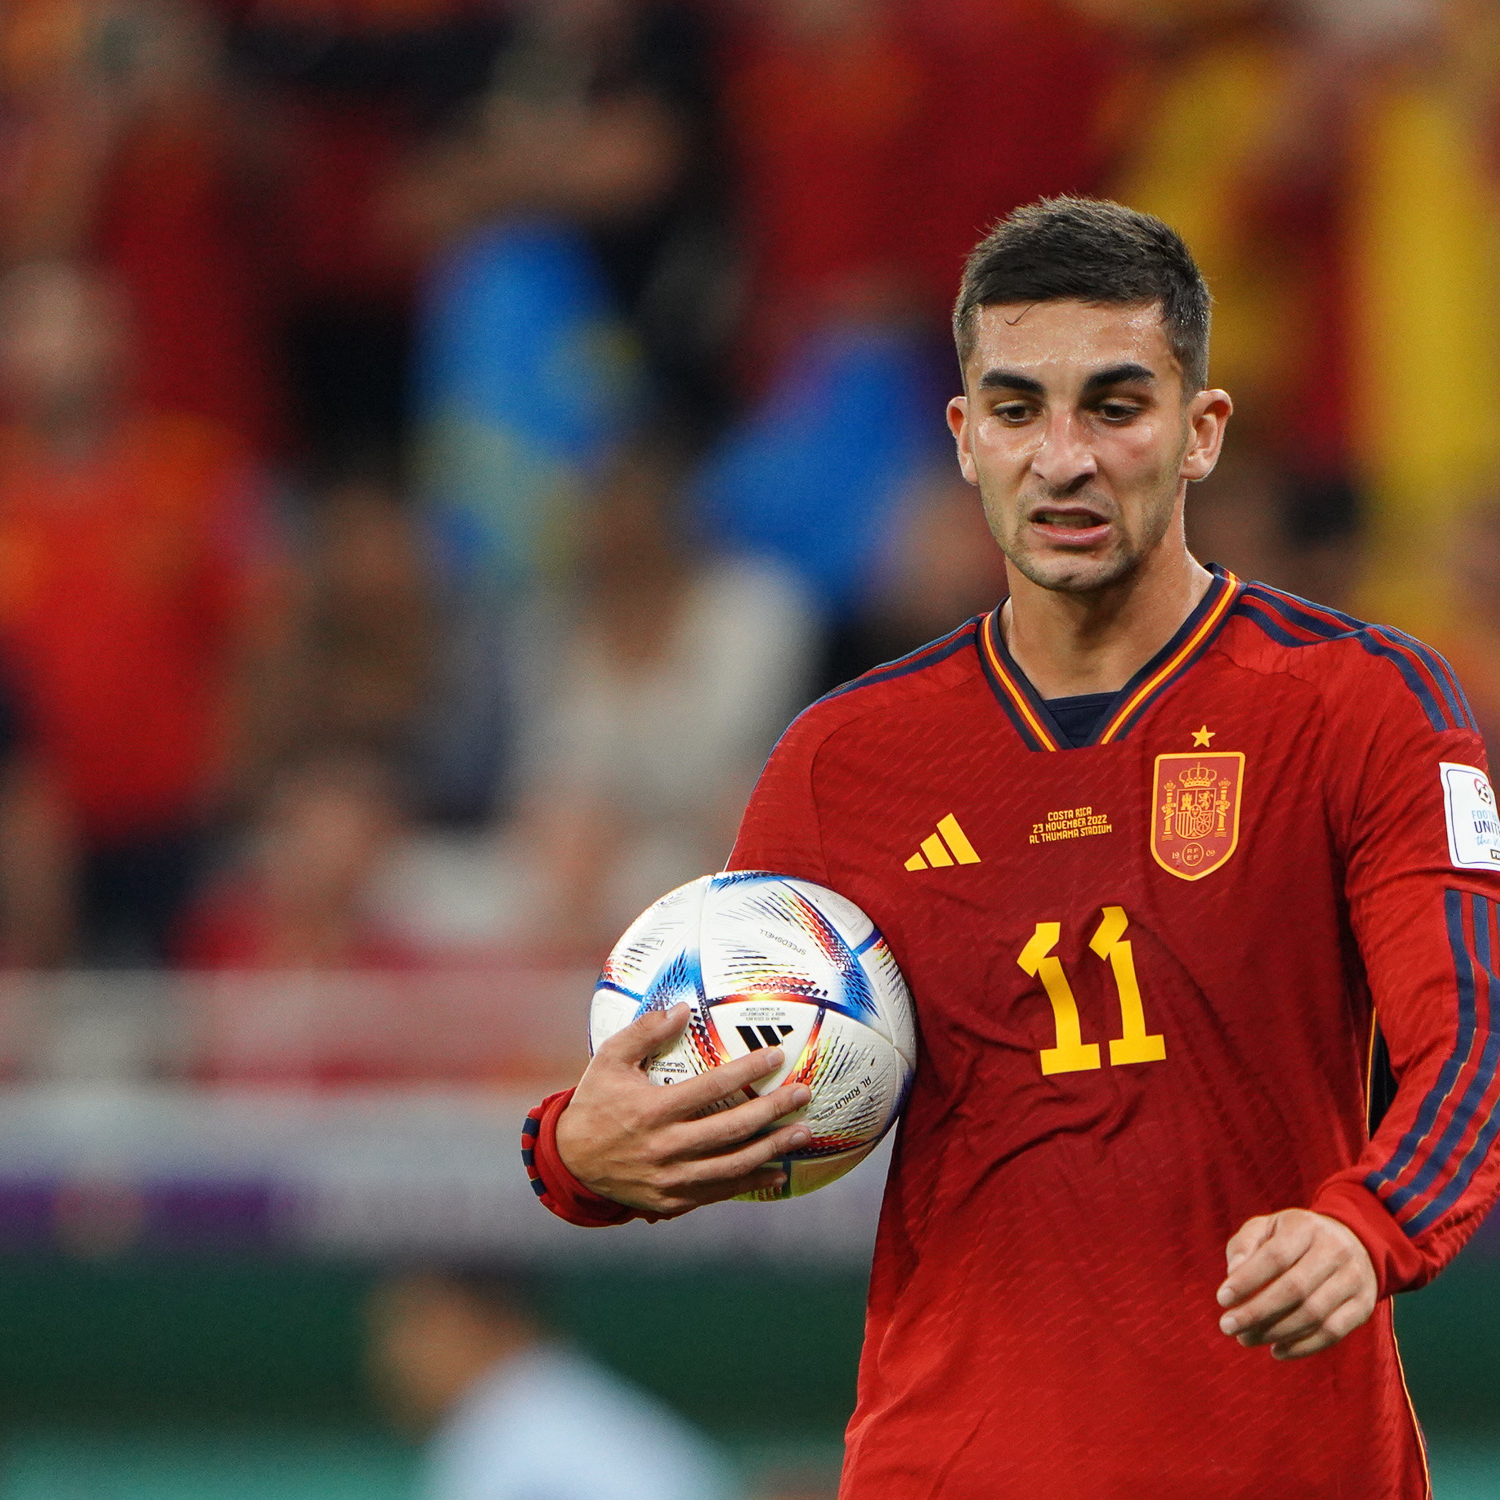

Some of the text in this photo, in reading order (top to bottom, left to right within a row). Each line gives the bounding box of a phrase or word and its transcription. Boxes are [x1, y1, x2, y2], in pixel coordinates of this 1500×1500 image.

[1032, 814, 1108, 834] 23 NOVEMBER 2022
[1048, 806, 1092, 821] COSTA RICA
[1029, 824, 1112, 844] AL THUMAMA STADIUM
[759, 928, 807, 956] SPEEDSHELL
[1016, 906, 1167, 1076] 11
[835, 1076, 872, 1109] AL RIHLA
